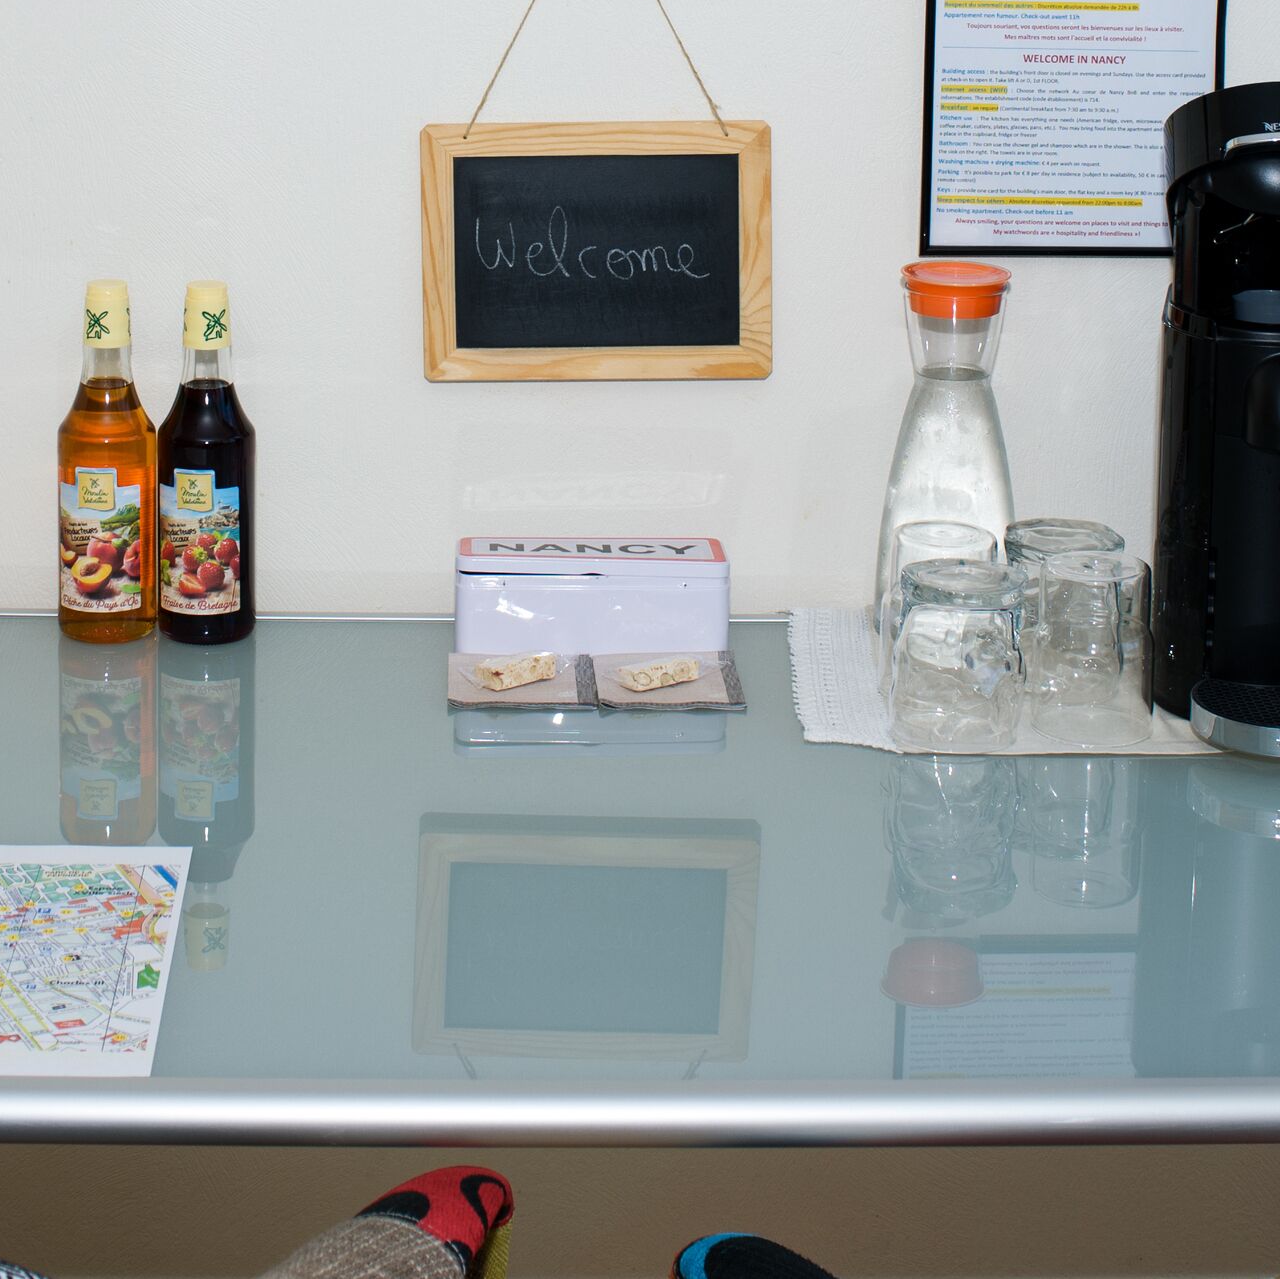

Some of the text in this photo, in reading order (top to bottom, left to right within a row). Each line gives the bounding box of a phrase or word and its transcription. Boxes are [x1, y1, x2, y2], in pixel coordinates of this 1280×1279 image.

[1023, 53, 1126, 65] WELCOME IN NANCY
[475, 205, 710, 280] Welcome
[489, 543, 696, 555] NANCY
[83, 599, 94, 609] du
[95, 599, 119, 611] Pays
[185, 600, 196, 610] de
[198, 599, 238, 611] Bretagne
